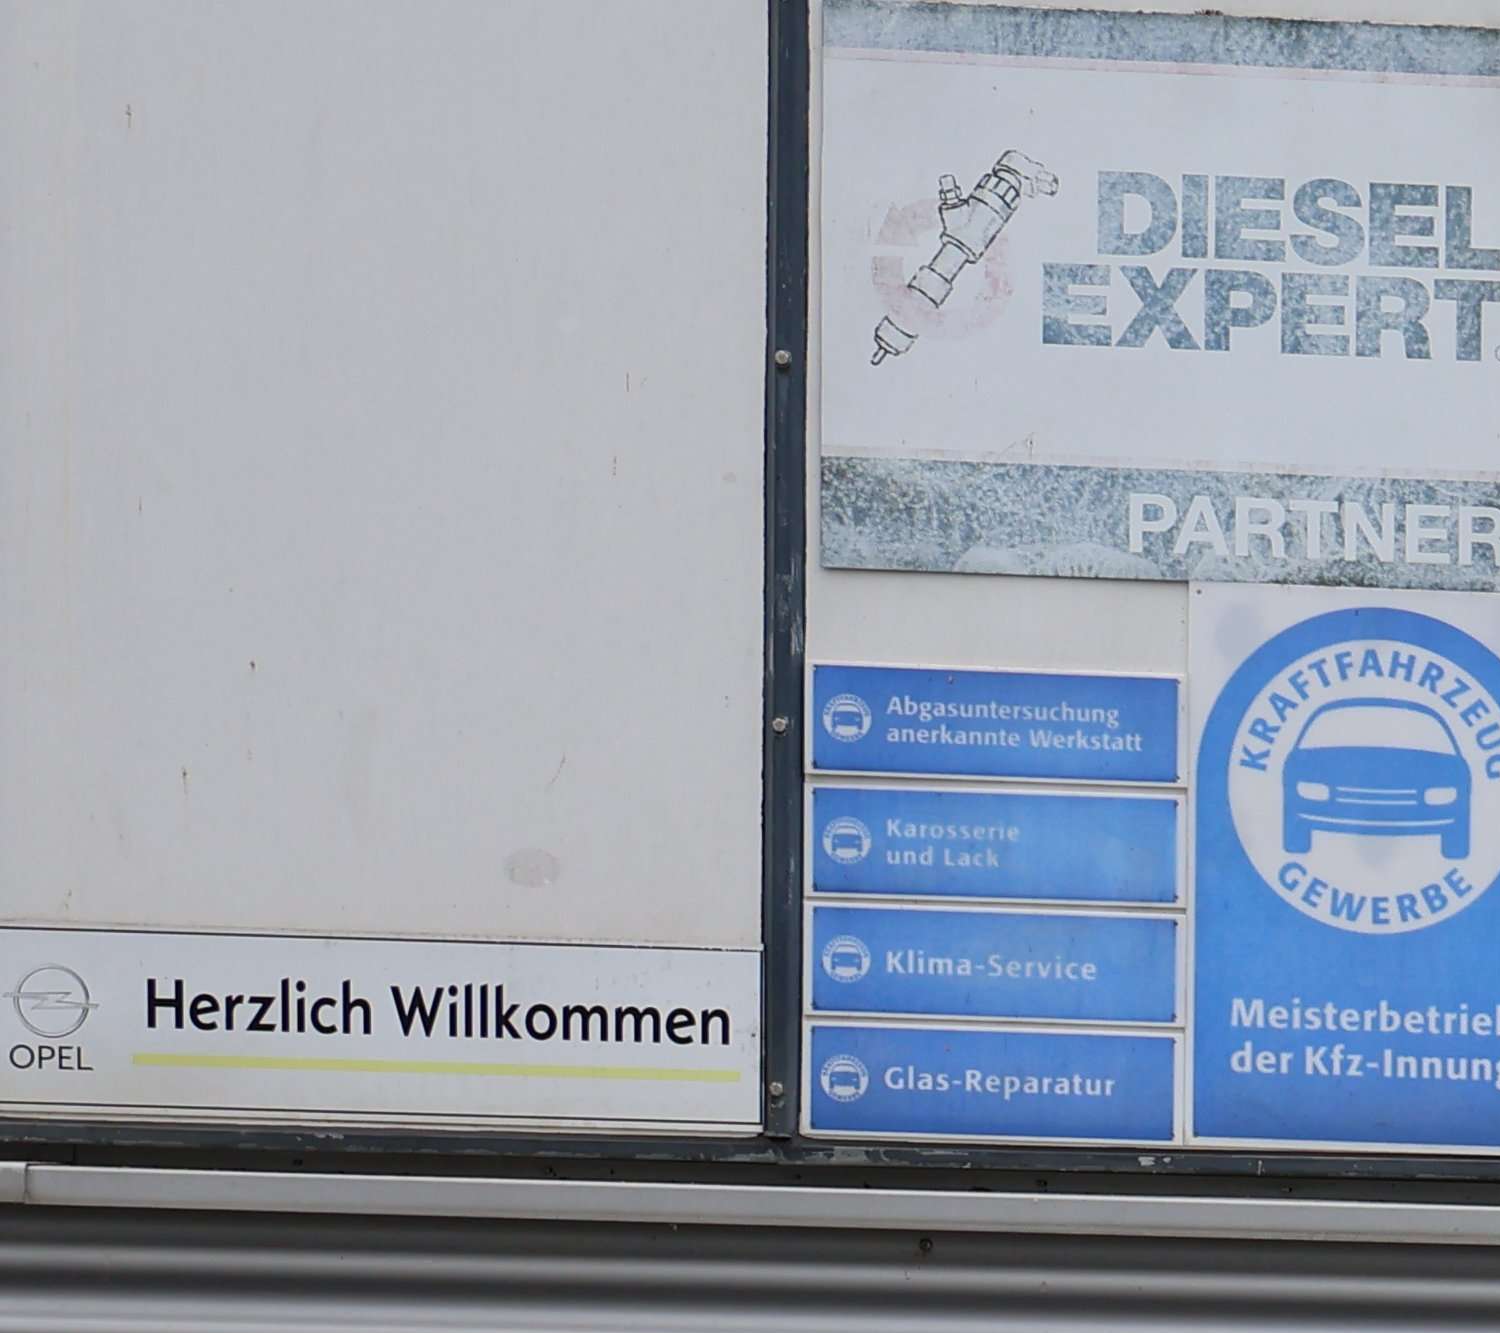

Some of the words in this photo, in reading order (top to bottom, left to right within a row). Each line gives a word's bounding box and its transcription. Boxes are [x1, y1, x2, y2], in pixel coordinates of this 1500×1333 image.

[886, 696, 1120, 729] Abgasuntersuchung
[886, 725, 1021, 748] anerkannte
[1029, 729, 1143, 752] Werkstatt
[886, 818, 1021, 842] Karosserie
[886, 846, 933, 866] und
[944, 847, 1000, 868] Lack
[1277, 860, 1473, 926] GEWERBE
[885, 948, 1098, 983] Klima-Service
[145, 977, 372, 1036] Herzlich
[390, 983, 732, 1046] Willkommen
[9, 1043, 94, 1072] OPEL
[1230, 1041, 1293, 1077] der
[883, 1065, 1117, 1101] Glas-Reparatur
